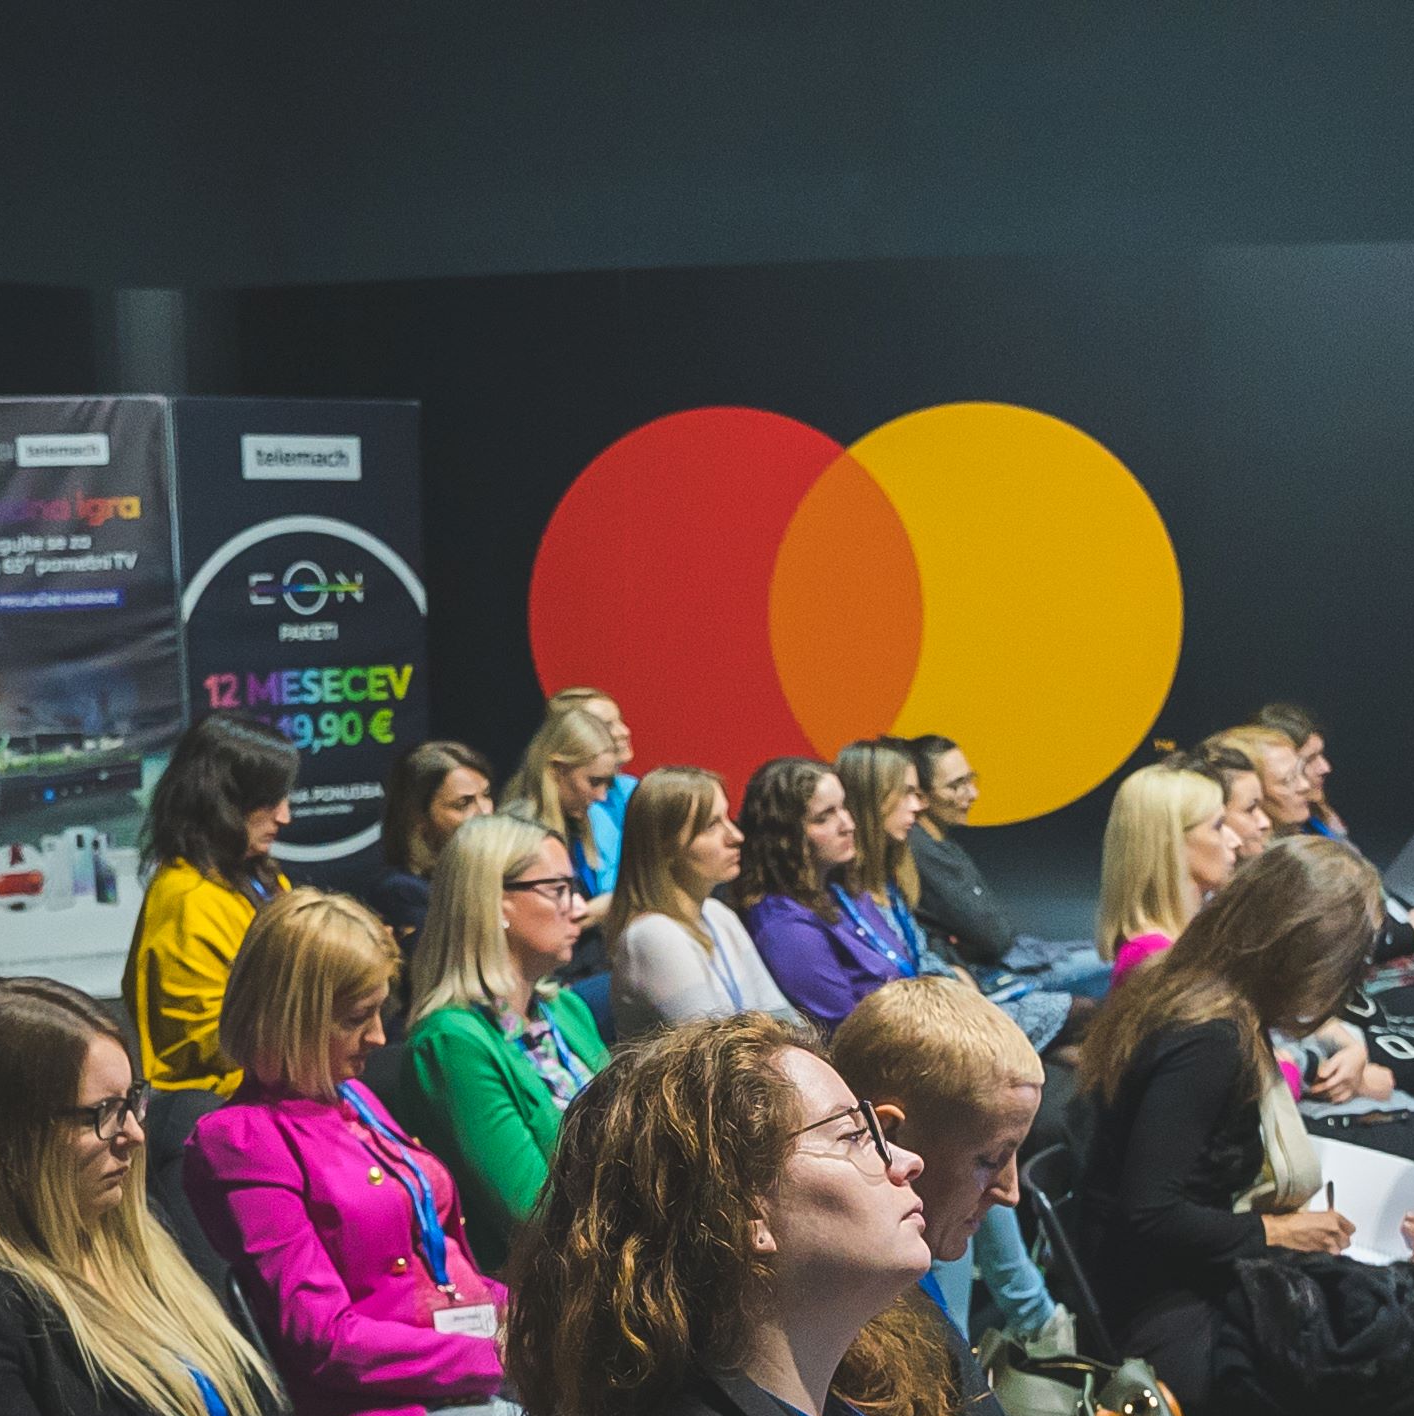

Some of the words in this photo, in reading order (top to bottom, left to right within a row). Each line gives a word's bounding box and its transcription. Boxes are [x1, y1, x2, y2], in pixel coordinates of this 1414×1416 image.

[255, 448, 351, 469] telemach
[112, 552, 138, 571] TV
[278, 622, 340, 642] PAKETI
[204, 673, 239, 709] 12
[248, 664, 413, 706] MESECEV
[369, 707, 395, 744] €
